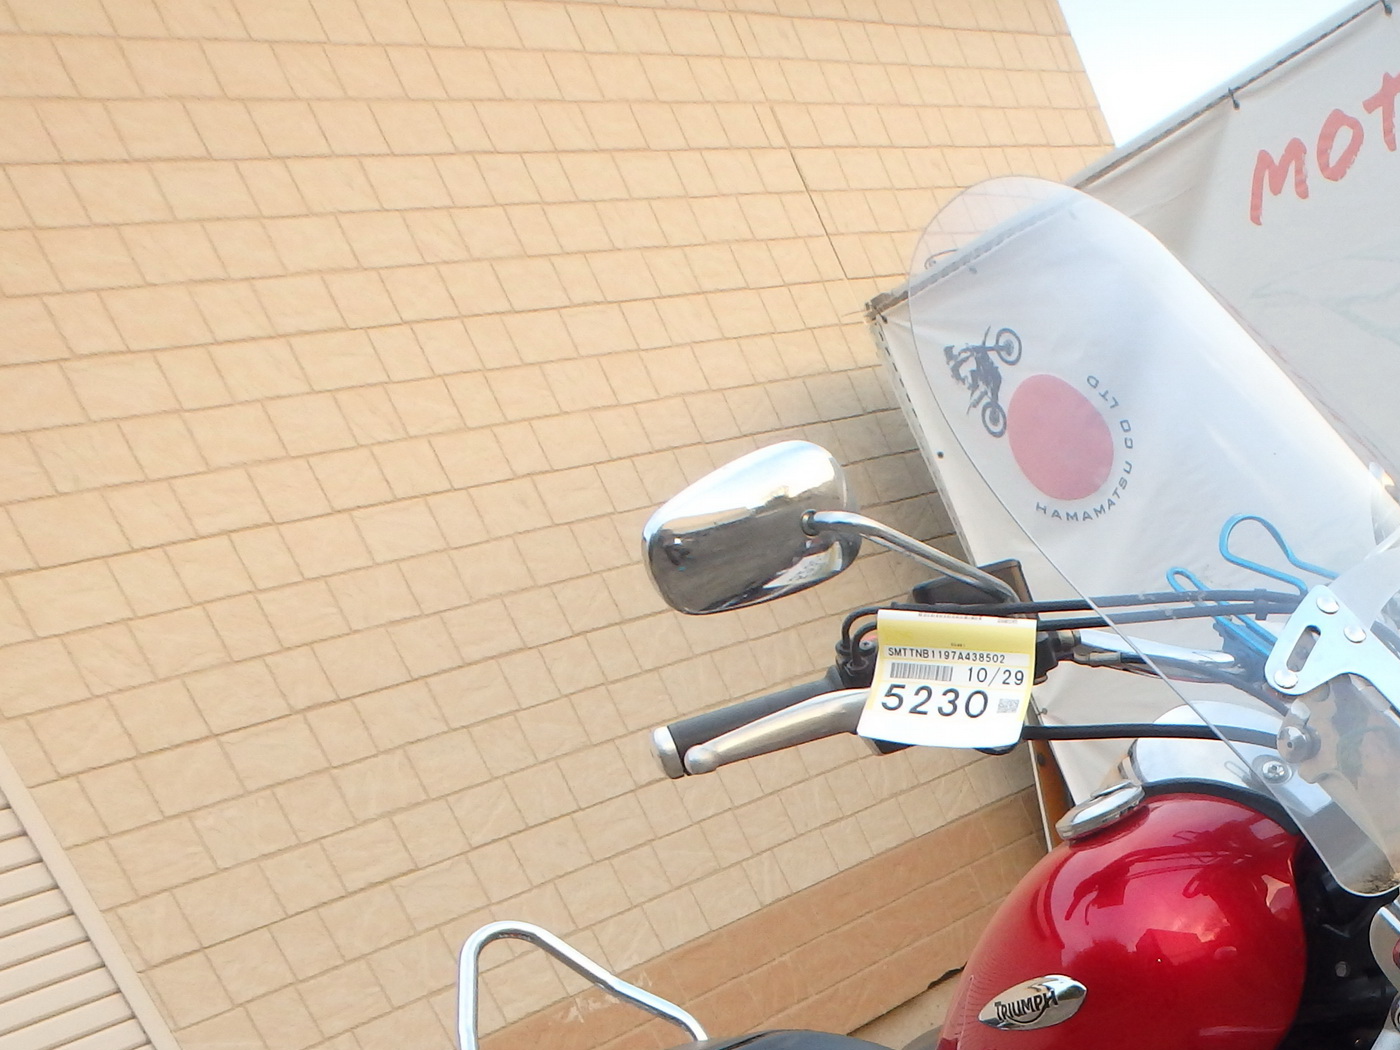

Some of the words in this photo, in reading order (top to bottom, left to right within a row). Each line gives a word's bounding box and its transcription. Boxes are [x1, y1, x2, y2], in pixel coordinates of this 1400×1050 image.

[1086, 375, 1119, 409] LTD
[1119, 419, 1134, 449] CO
[1036, 461, 1133, 521] HAMAMATSU
[888, 647, 1006, 664] SMTTNB1197A438502
[968, 666, 1025, 687] 10/29
[881, 683, 989, 719] 5230
[994, 990, 1059, 1022] TRIUMPH
